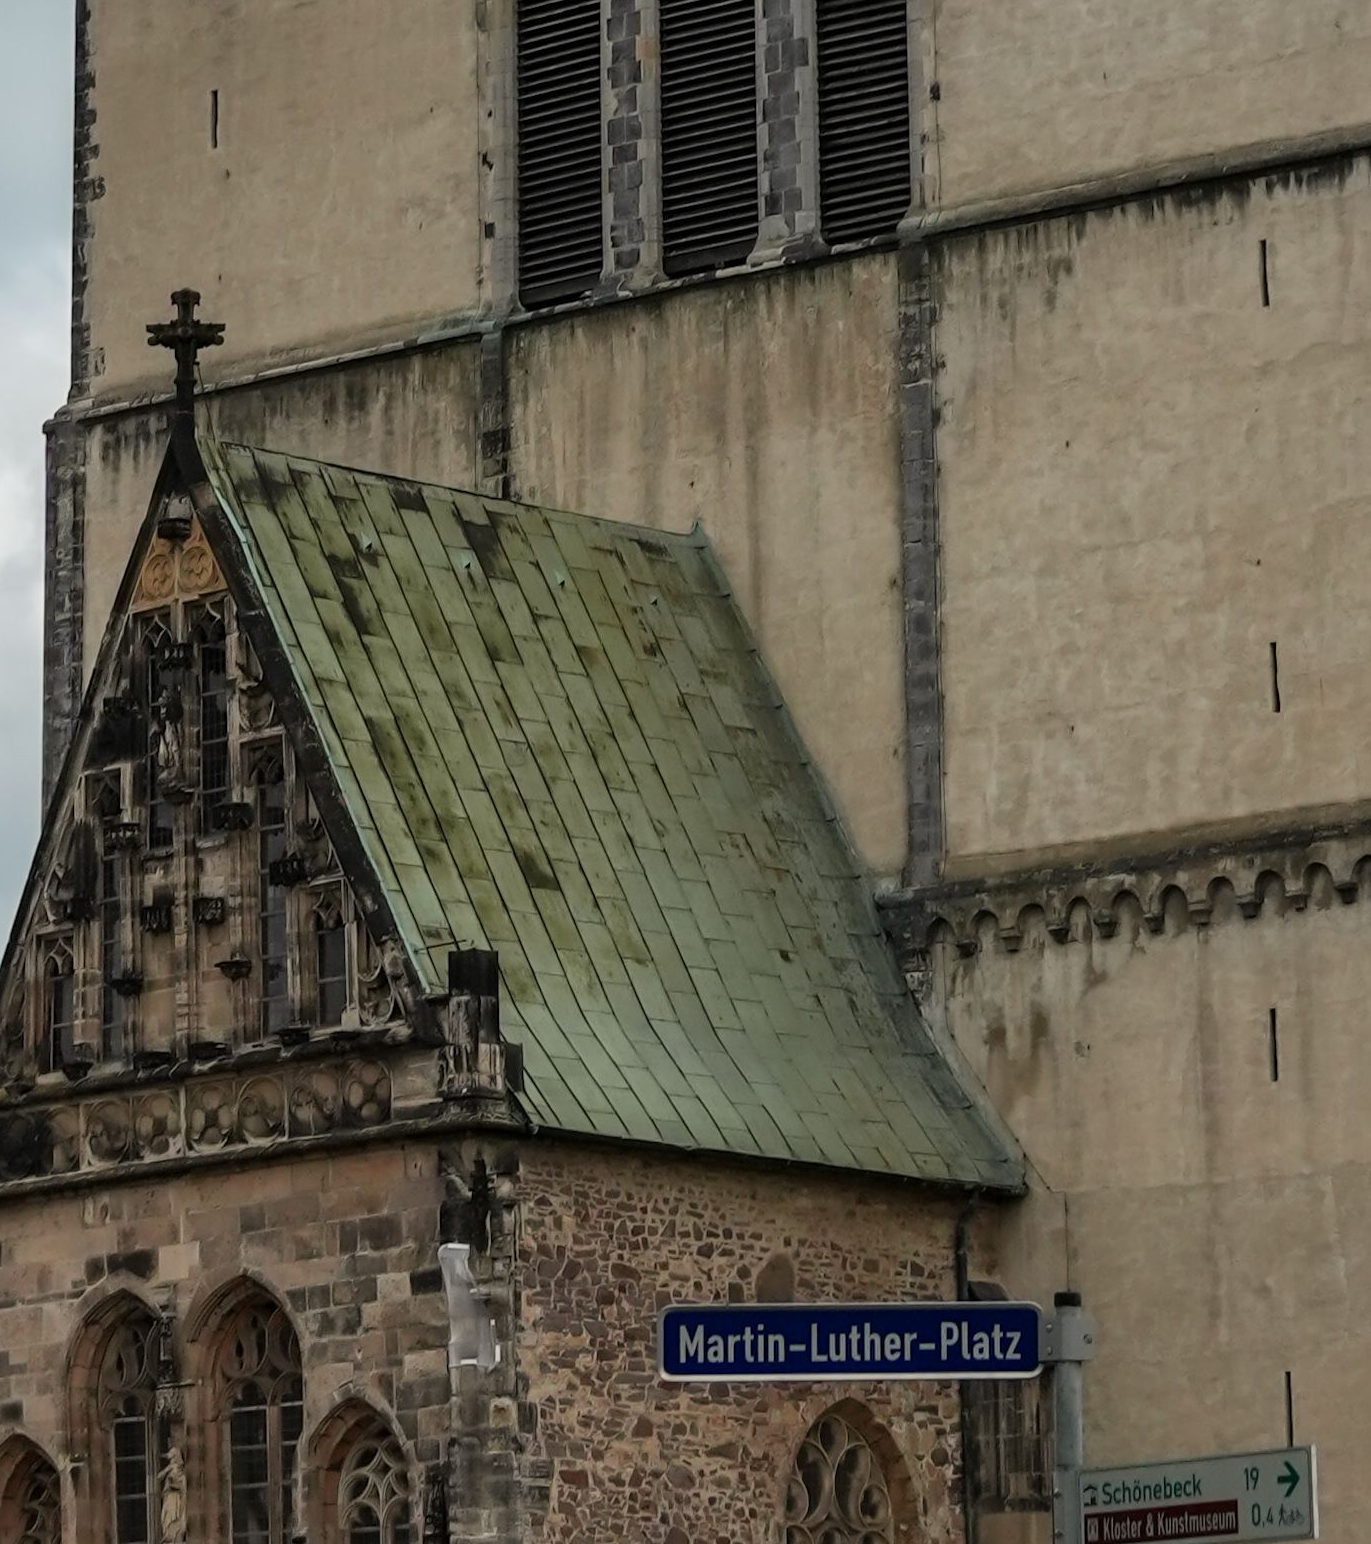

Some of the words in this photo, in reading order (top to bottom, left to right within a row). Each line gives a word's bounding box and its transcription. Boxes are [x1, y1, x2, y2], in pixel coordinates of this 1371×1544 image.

[678, 1320, 1022, 1364] Martin-Luther-Platz
[1101, 1473, 1203, 1505] Schönebeck
[1244, 1466, 1259, 1491] 19
[1103, 1514, 1142, 1541] Kloster
[1146, 1512, 1155, 1536] &
[1157, 1509, 1237, 1536] Kunstmuseum
[1251, 1503, 1275, 1528] 0,4
